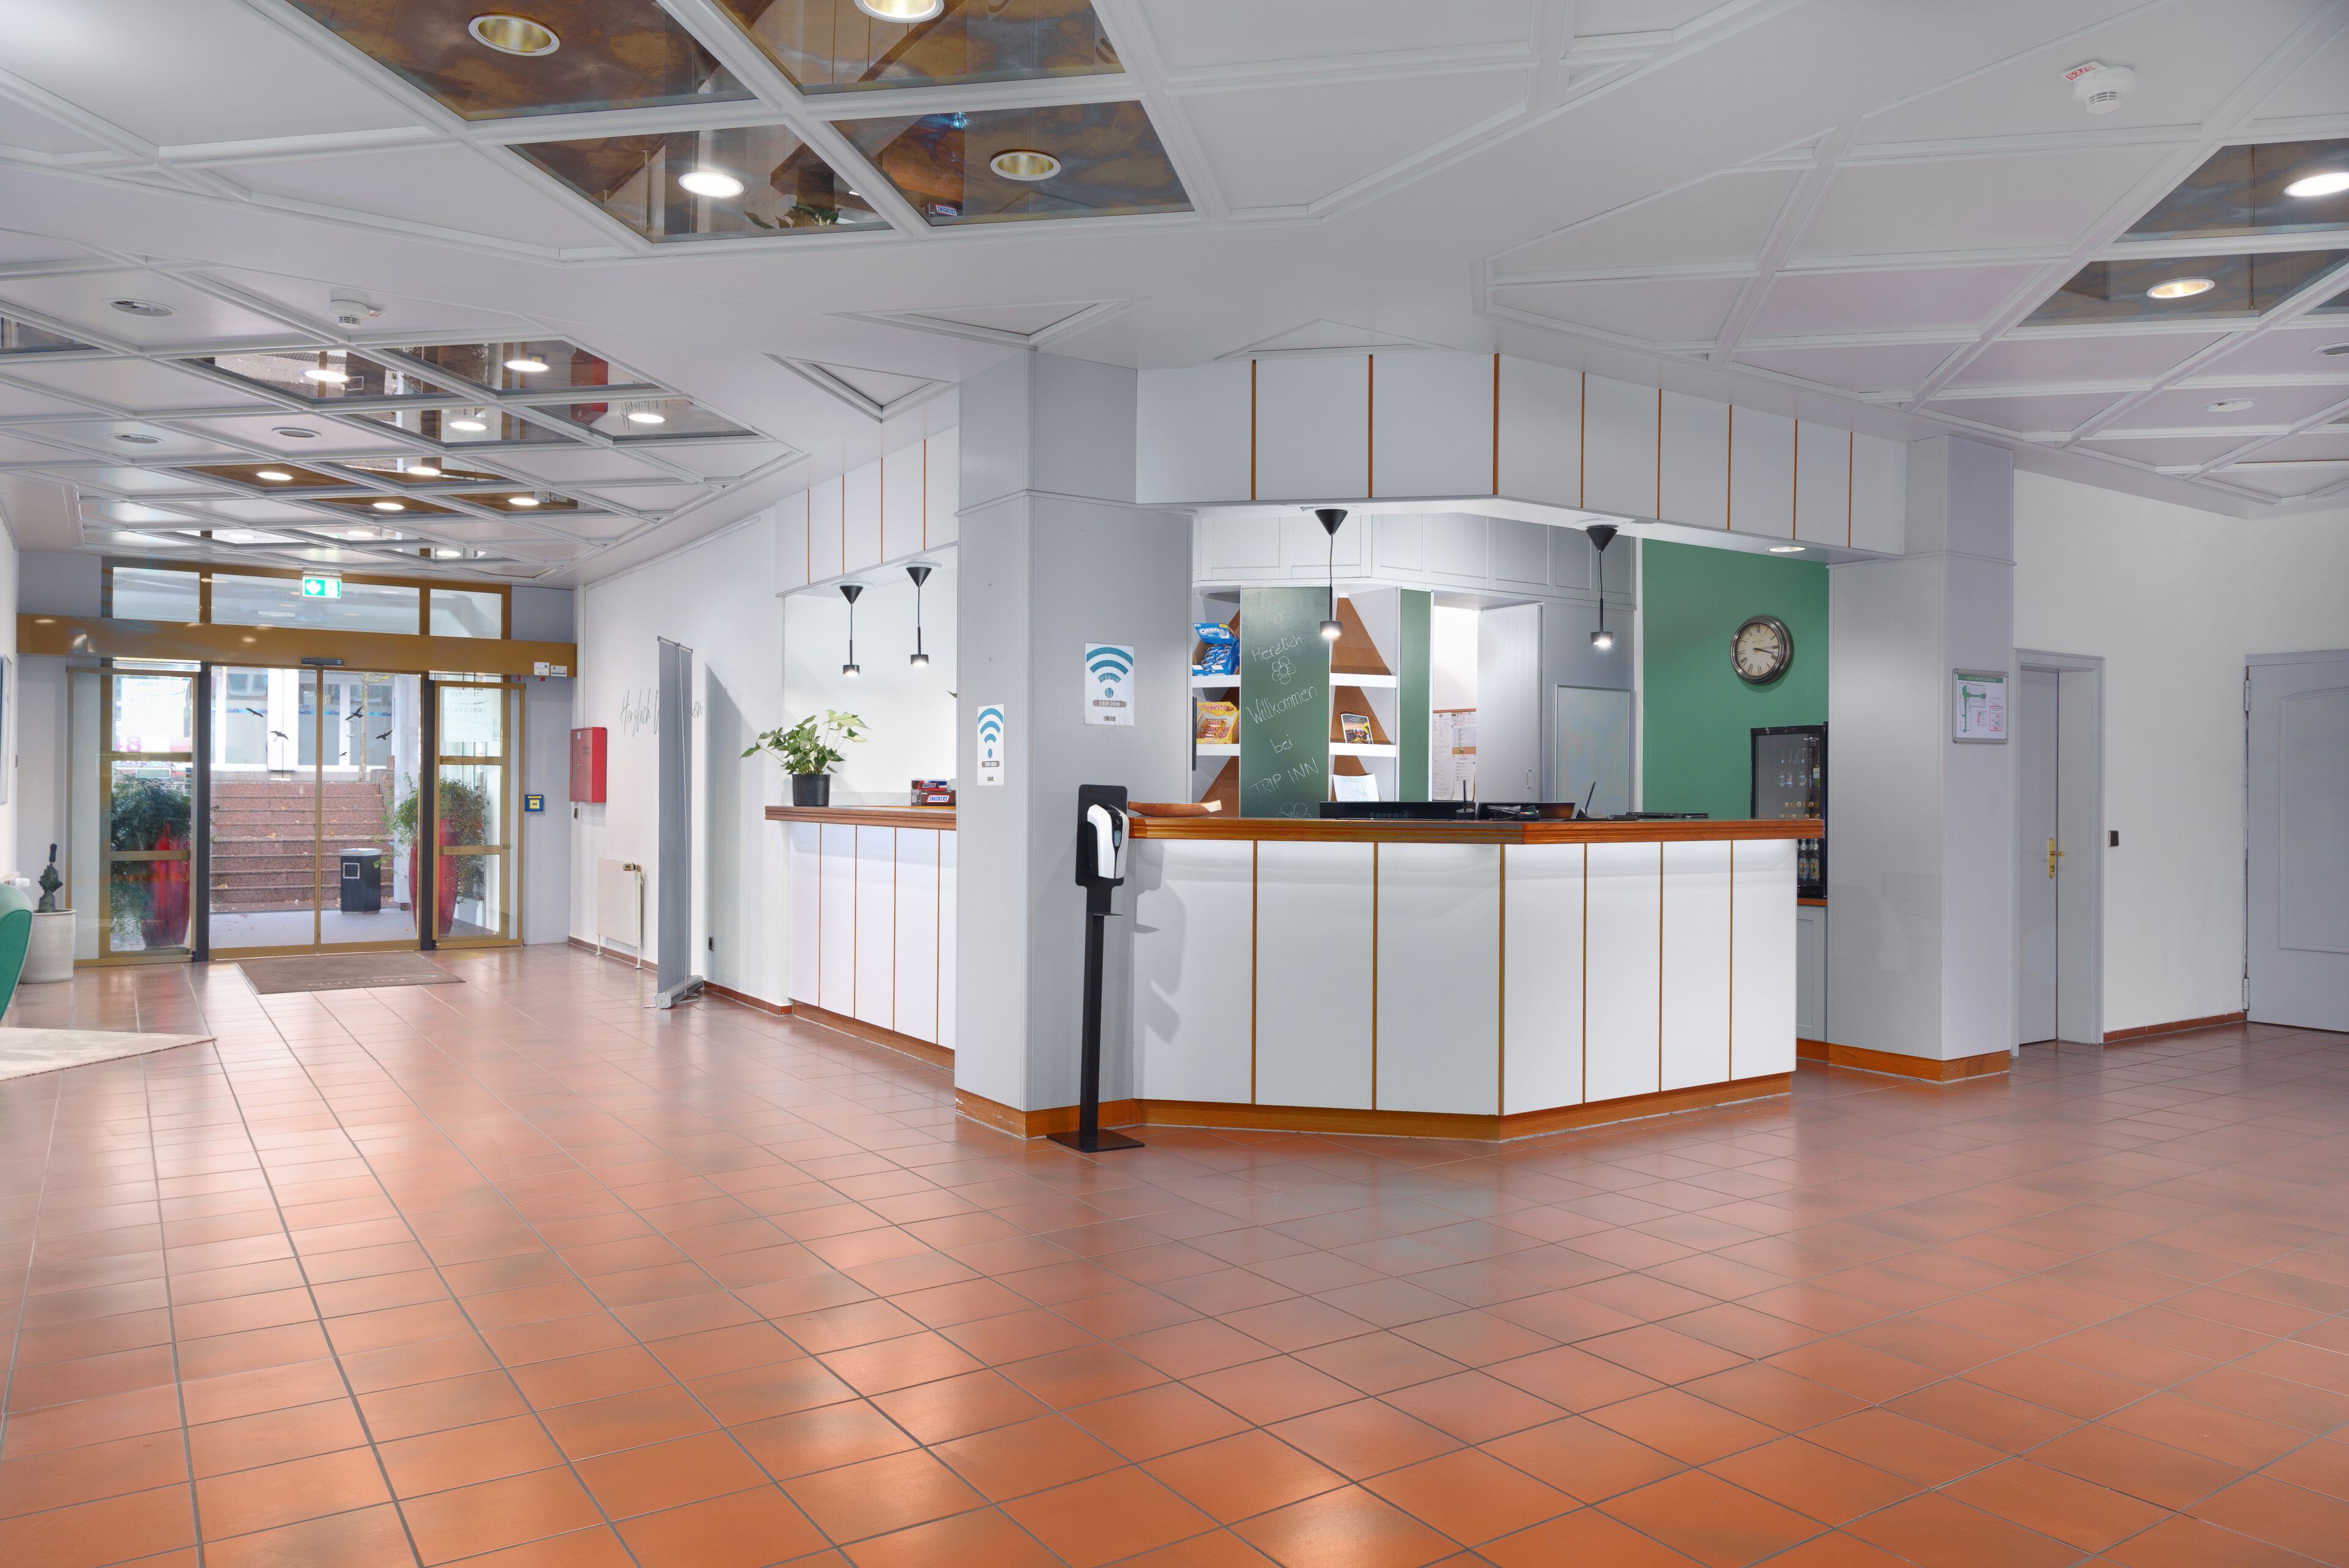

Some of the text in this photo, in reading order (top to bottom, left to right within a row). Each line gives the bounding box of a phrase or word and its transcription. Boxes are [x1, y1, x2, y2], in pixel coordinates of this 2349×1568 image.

[1250, 635, 1303, 662] Herzlich
[1245, 686, 1318, 724] Willkommen
[1249, 757, 1319, 795] TRIP INN
